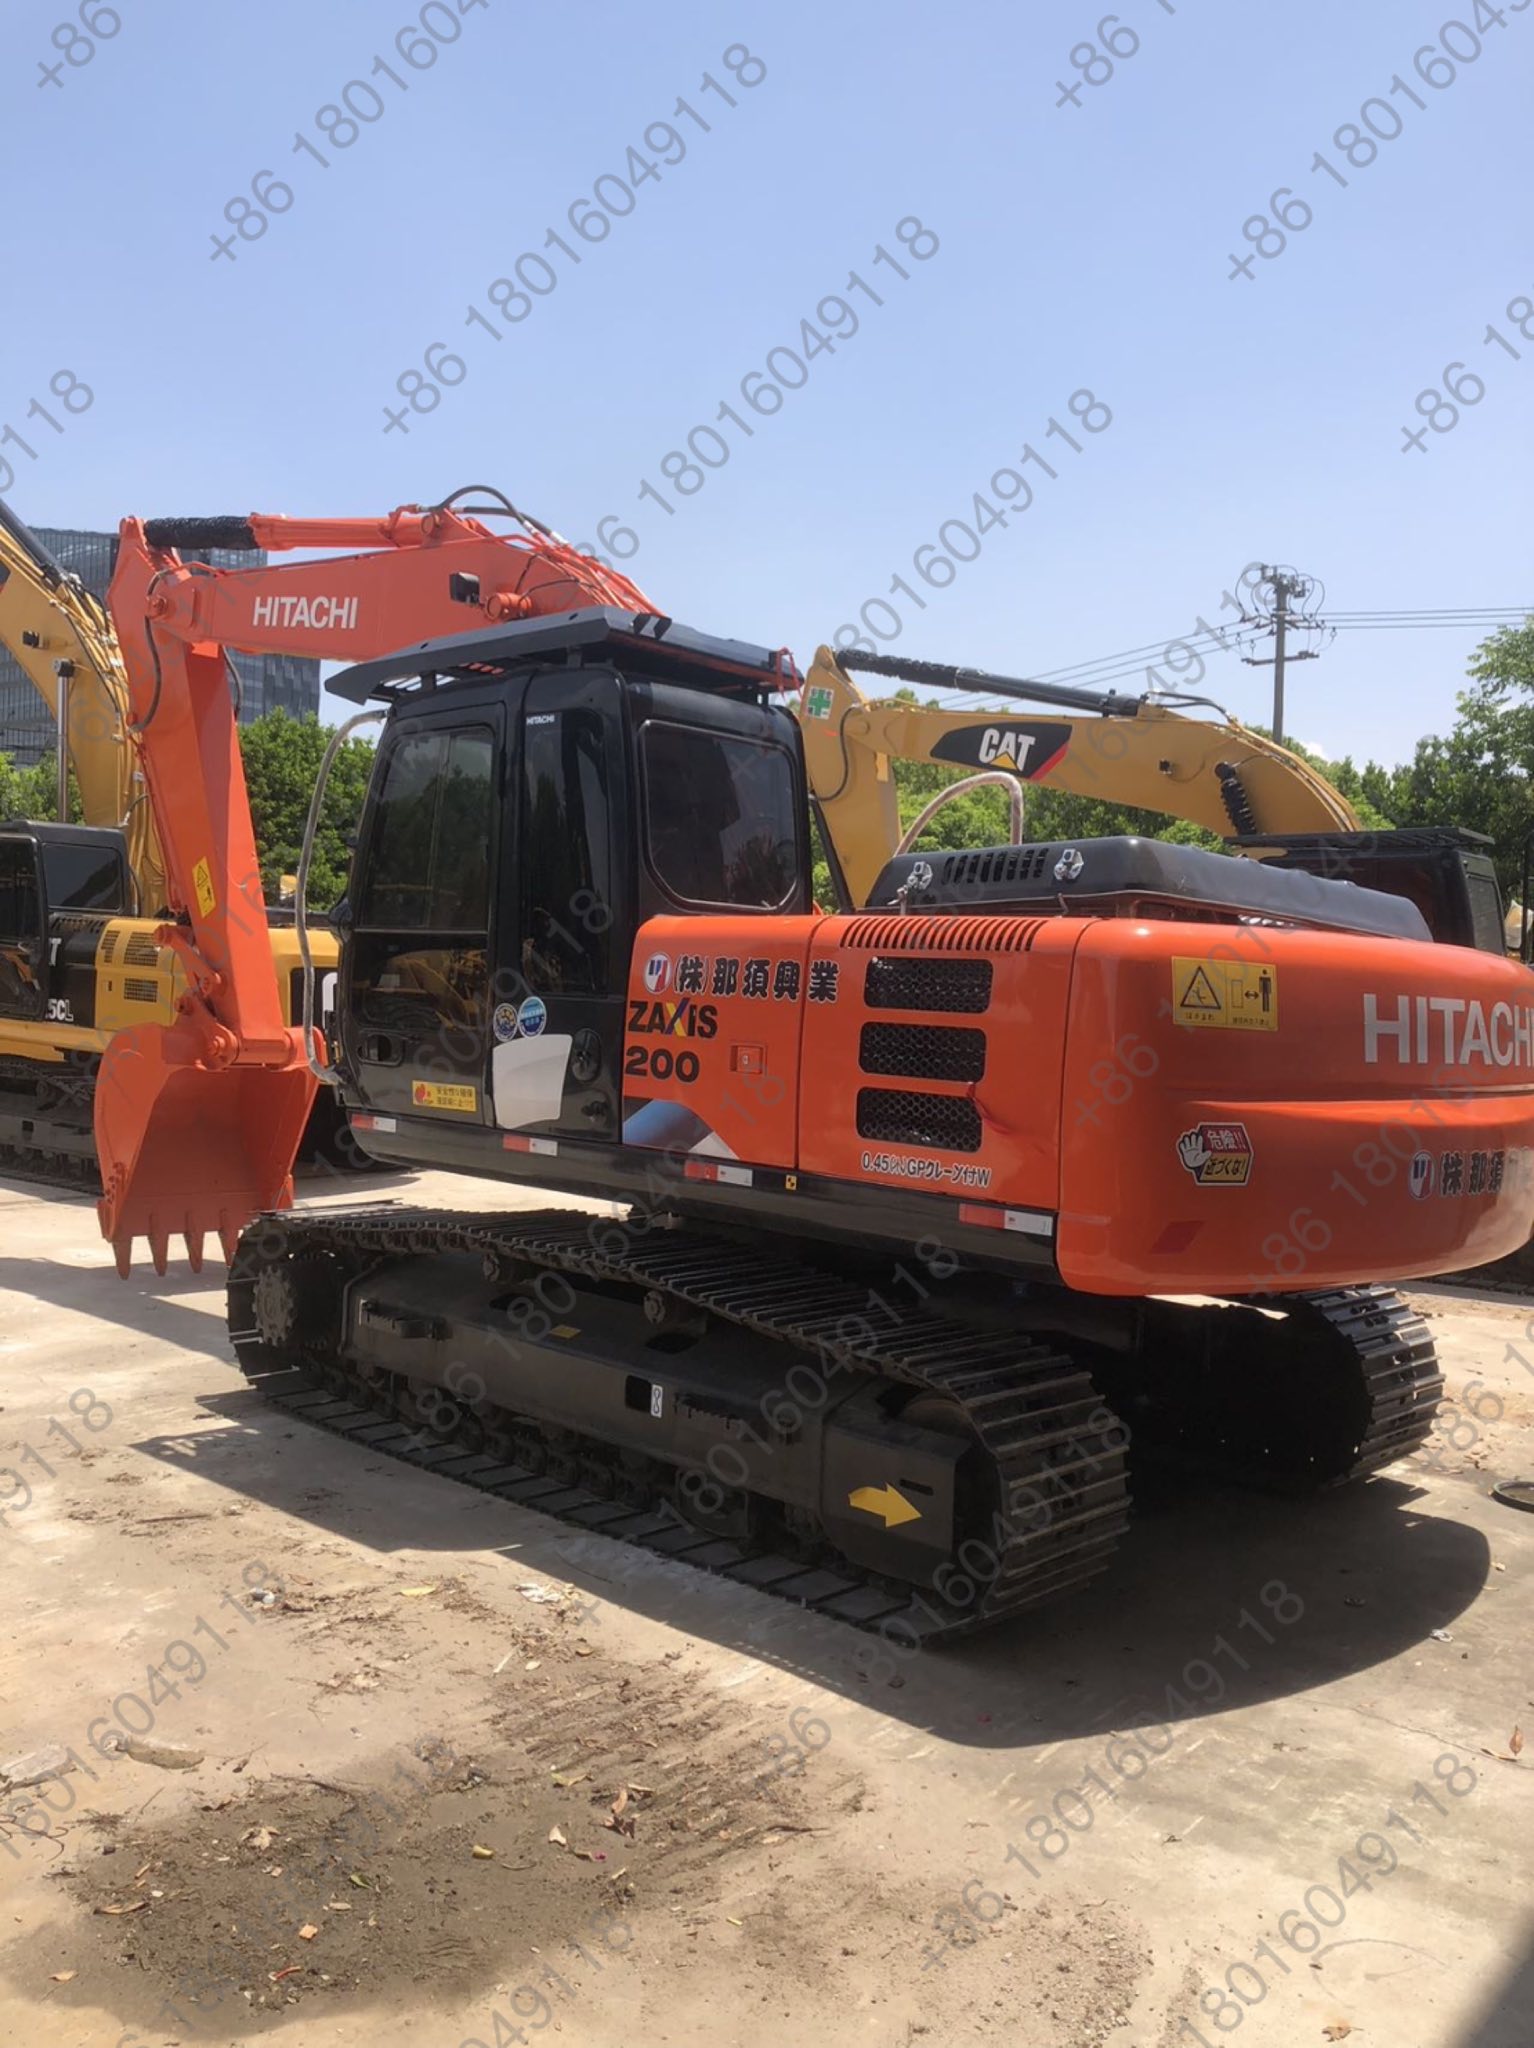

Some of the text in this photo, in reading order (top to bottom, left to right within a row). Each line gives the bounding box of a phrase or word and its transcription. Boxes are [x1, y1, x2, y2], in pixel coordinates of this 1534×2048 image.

[253, 596, 358, 629] HITACHI
[979, 727, 1036, 772] CAT
[47, 998, 74, 1022] 5CL
[627, 997, 718, 1039] ZAXIS
[625, 1045, 700, 1083] 200
